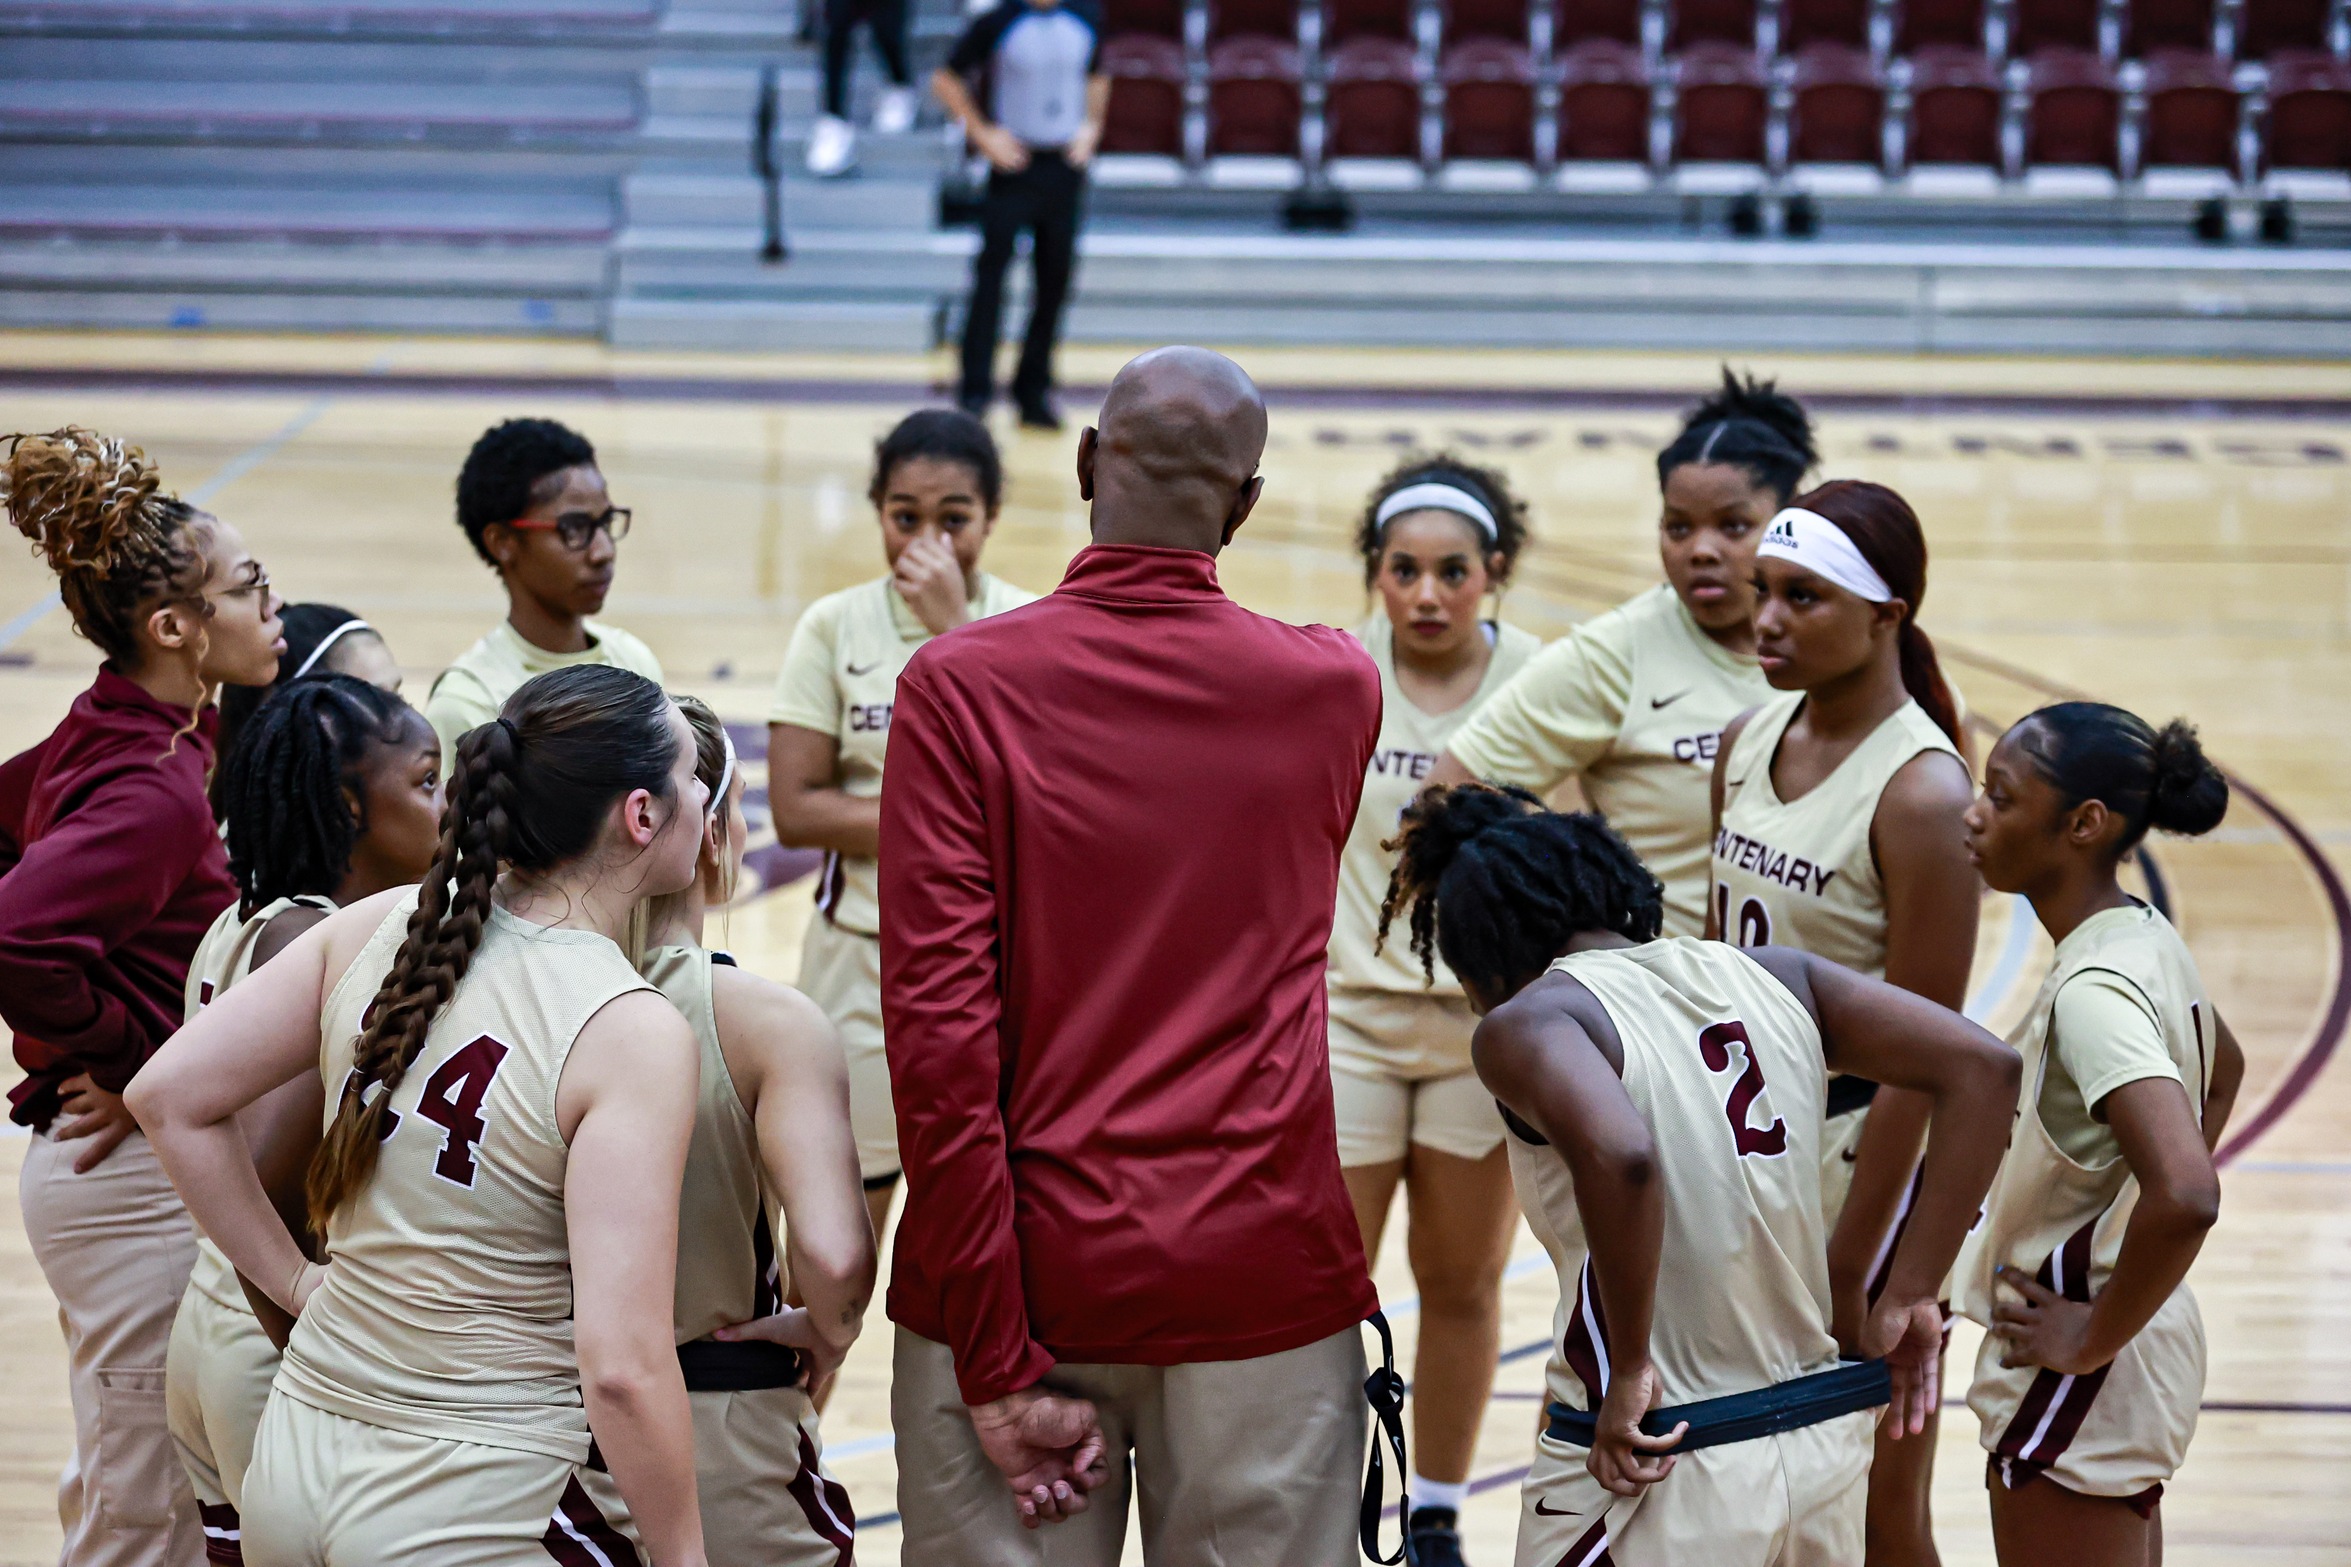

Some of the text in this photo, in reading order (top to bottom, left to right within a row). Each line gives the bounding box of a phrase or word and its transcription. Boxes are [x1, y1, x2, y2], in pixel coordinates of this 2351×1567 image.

[1674, 731, 1724, 763] CE
[1372, 750, 1438, 780] NTE
[1697, 1018, 1788, 1159] 2
